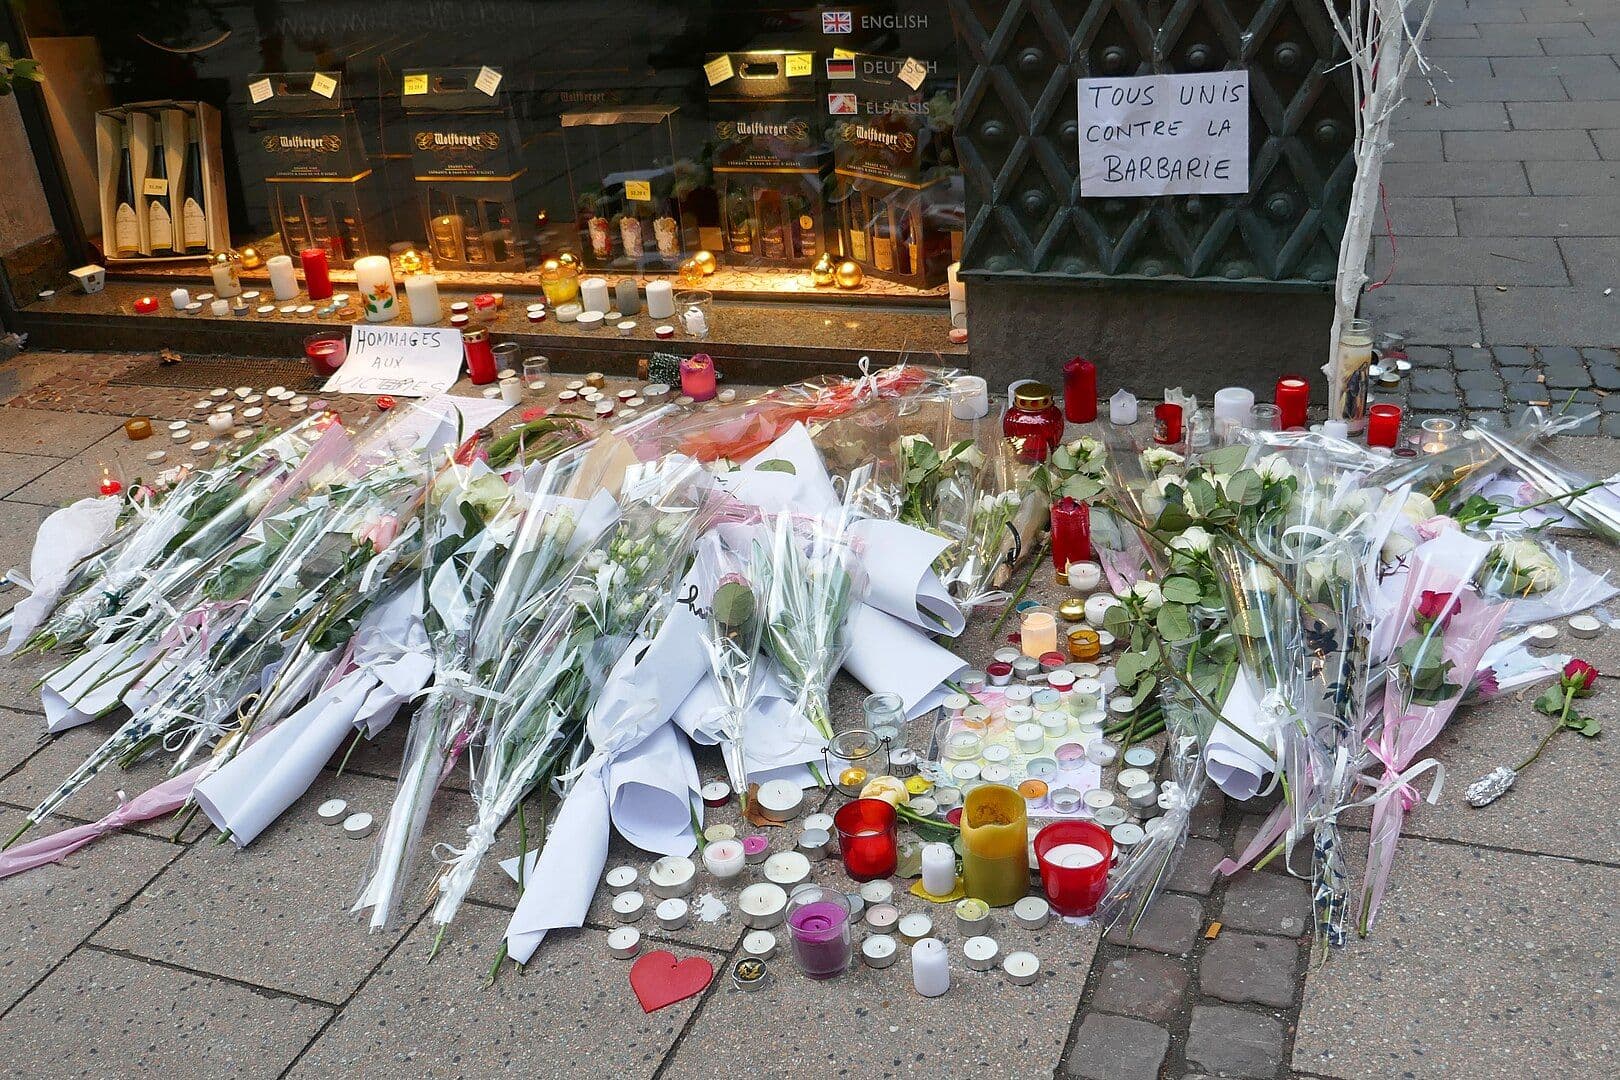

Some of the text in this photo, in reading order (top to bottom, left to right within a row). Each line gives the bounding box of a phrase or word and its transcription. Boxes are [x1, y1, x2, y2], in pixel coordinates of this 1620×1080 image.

[861, 15, 928, 29] ENGLISH
[863, 60, 937, 74] DEUTSCH
[1088, 84, 1155, 108] TOUS
[737, 122, 788, 136] Wolfberger
[856, 126, 898, 145] Wolfberger
[1086, 119, 1232, 143] CONTRE LA
[280, 136, 324, 149] Wolfberger
[434, 133, 481, 147] Wolfberger
[356, 329, 441, 354] HOMMAGES
[371, 356, 404, 369] AUX
